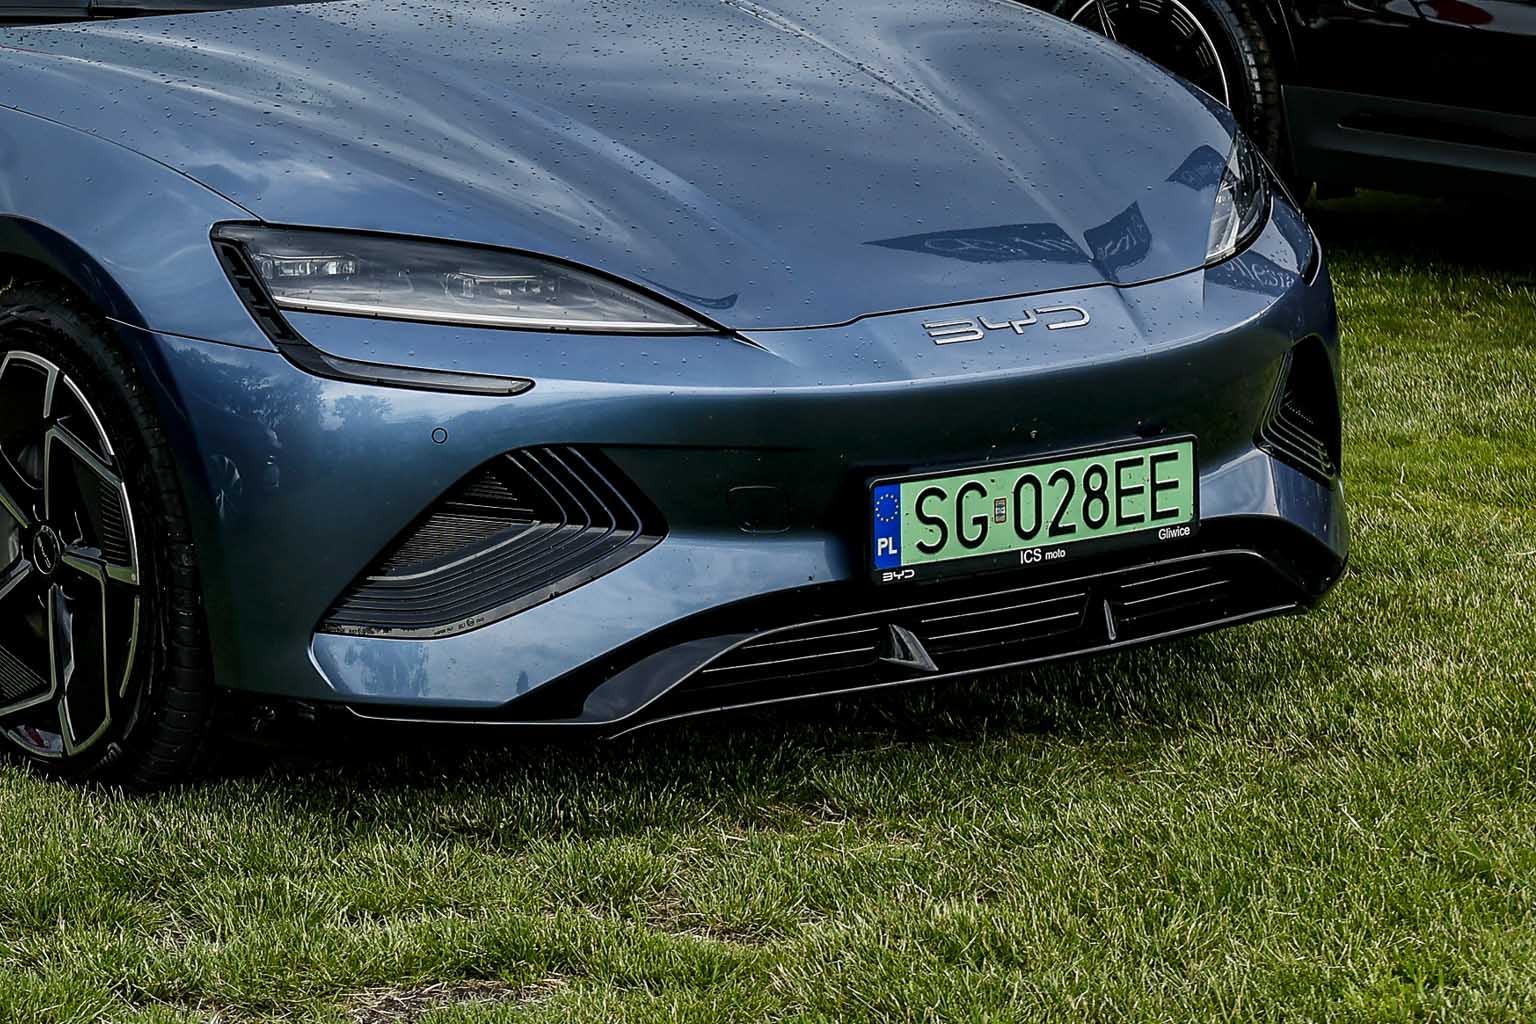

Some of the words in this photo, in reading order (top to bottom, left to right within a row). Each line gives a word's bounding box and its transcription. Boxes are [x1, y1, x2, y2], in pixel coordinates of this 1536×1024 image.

[921, 305, 1091, 346] BYD
[914, 480, 990, 556] SG
[1012, 451, 1180, 541] 028EE
[1157, 525, 1192, 541] Gliwice
[876, 537, 898, 557] PL
[1019, 548, 1043, 565] ICS
[1044, 548, 1067, 561] moto
[881, 569, 915, 583] BYD
